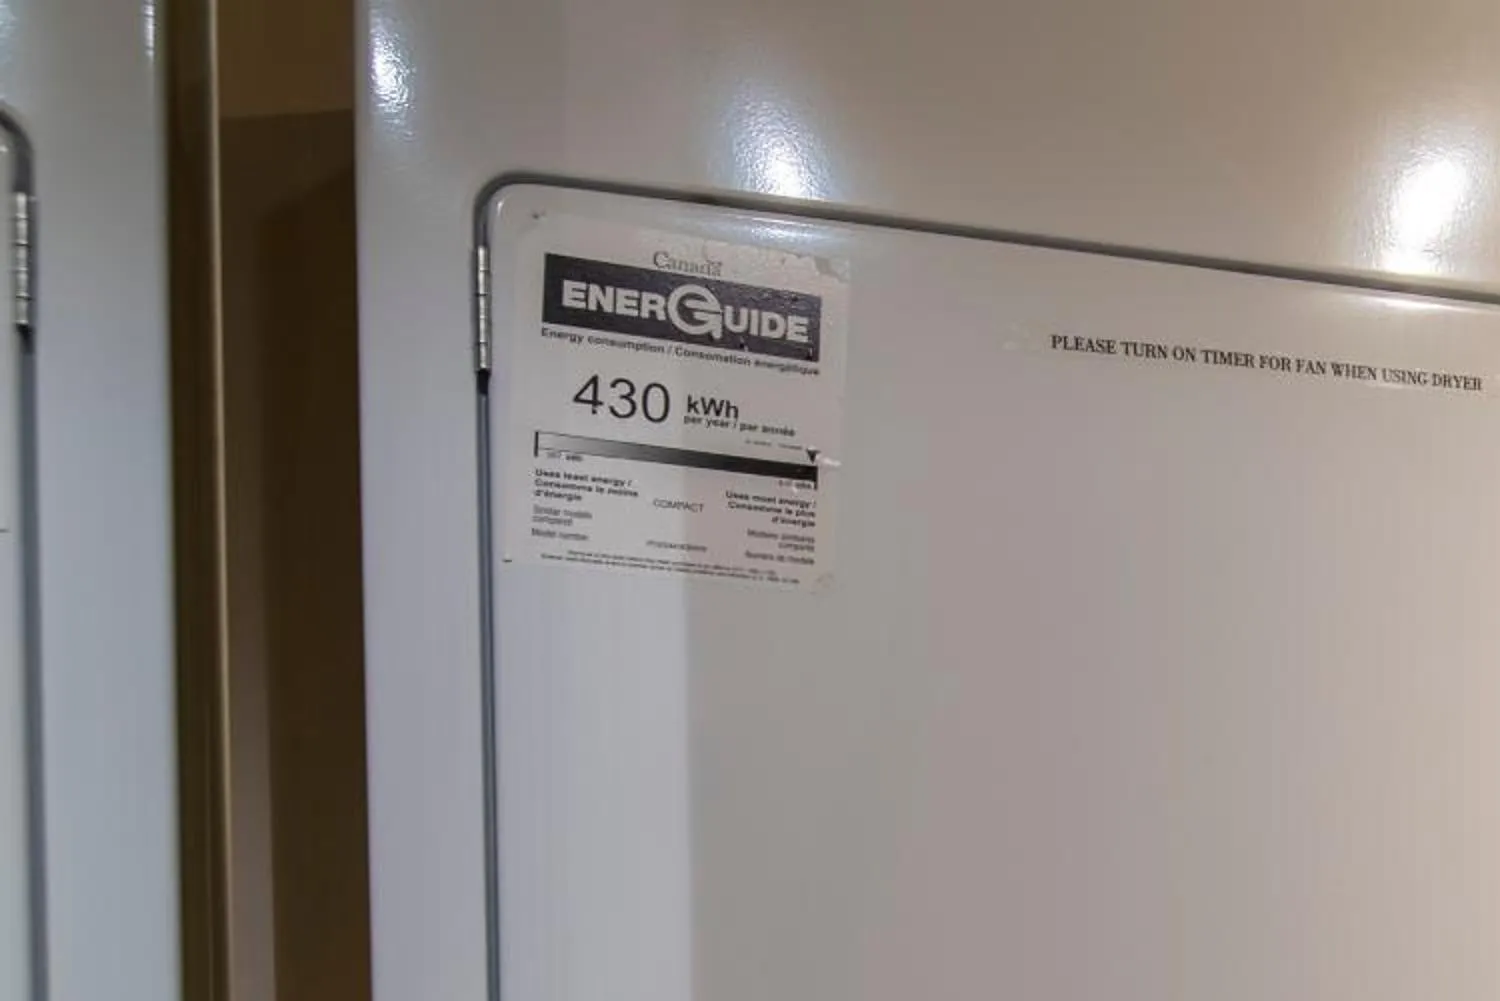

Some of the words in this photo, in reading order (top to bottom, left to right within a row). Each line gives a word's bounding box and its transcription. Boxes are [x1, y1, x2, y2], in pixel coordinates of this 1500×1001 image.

[562, 279, 810, 342] ENERGUIDE
[541, 327, 585, 344] Energy
[587, 334, 665, 354] consumption
[1050, 333, 1117, 356] PLEASE
[1119, 340, 1169, 361] TURN
[1172, 345, 1197, 362] ON
[1200, 348, 1256, 369] TIMER
[1258, 353, 1292, 373] FOR
[1296, 358, 1328, 376] FAN
[1330, 361, 1378, 382] WHEN
[1381, 367, 1429, 387] USING
[1431, 372, 1483, 392] DRYER
[571, 373, 671, 424] 430
[686, 394, 740, 419] kWh
[652, 498, 705, 513] COMPACT
